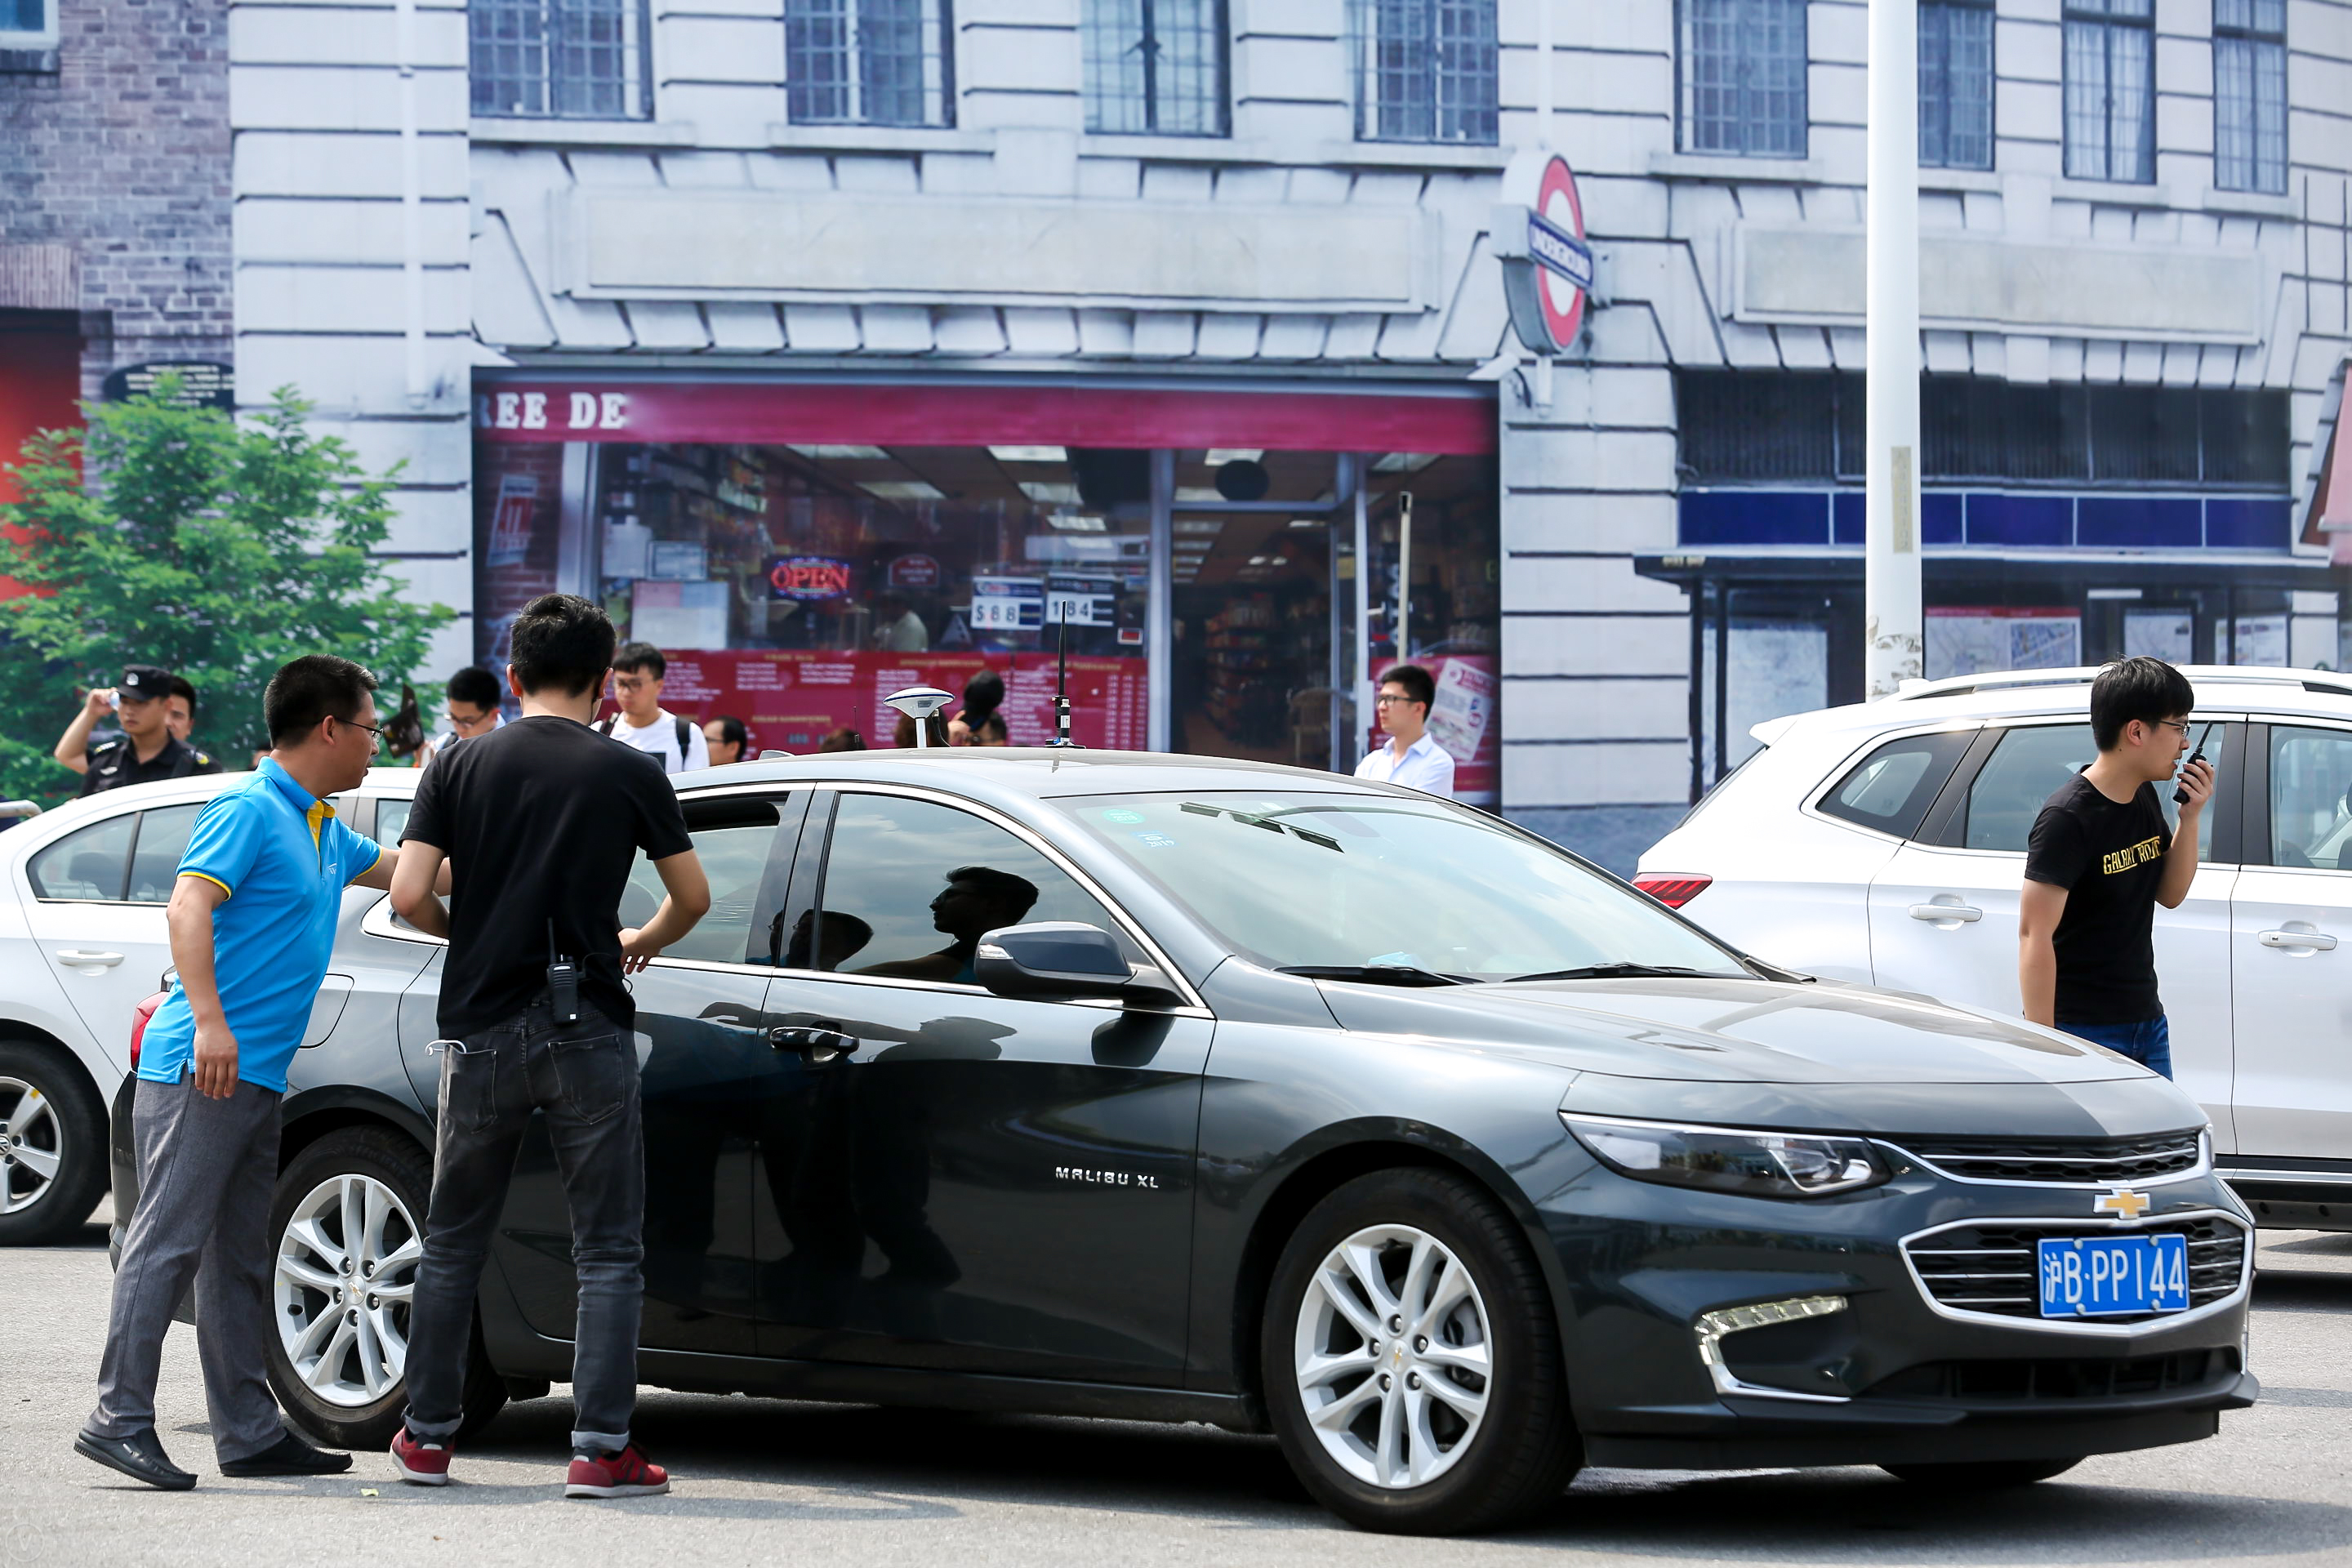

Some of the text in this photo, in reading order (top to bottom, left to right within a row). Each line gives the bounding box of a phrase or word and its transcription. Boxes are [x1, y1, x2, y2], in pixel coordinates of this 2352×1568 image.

[568, 392, 628, 430] DE
[771, 565, 850, 591] OPEN
[2103, 847, 2136, 875] GALAXY
[1055, 1166, 1159, 1188] MALIBU XL
